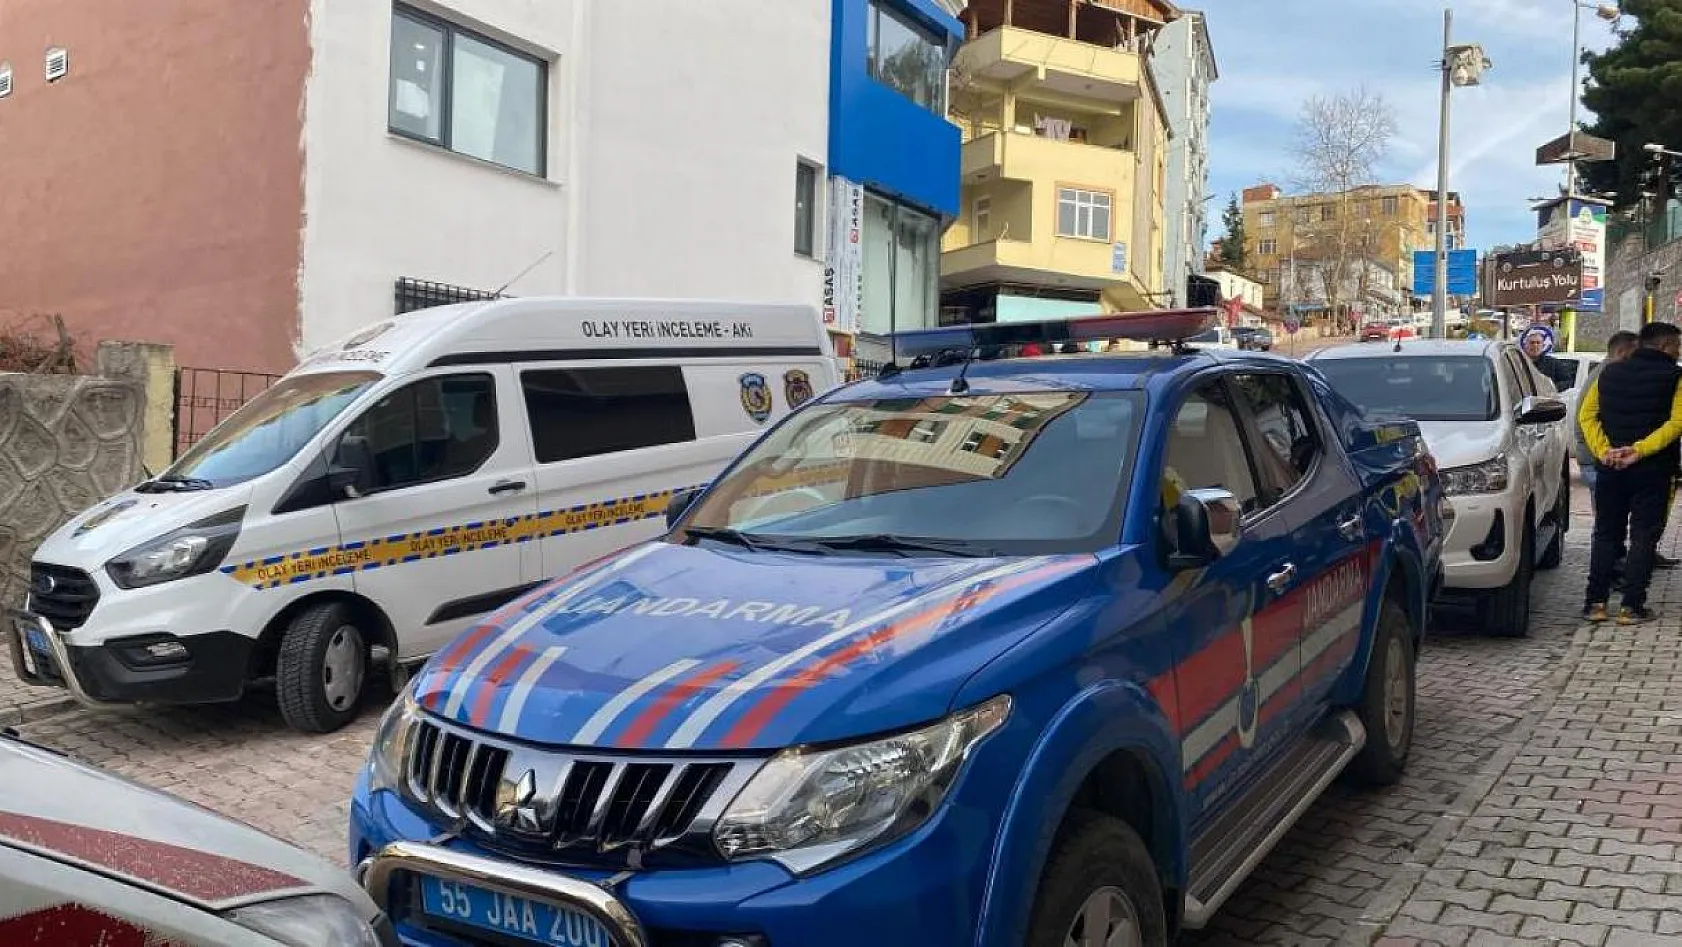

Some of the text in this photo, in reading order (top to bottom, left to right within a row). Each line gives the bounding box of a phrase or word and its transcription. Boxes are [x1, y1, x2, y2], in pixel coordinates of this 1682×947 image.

[1497, 274, 1578, 291] Kurtuluş Yolu
[582, 320, 618, 338] OLAY
[440, 879, 472, 919] 55
[487, 891, 538, 936] JAA
